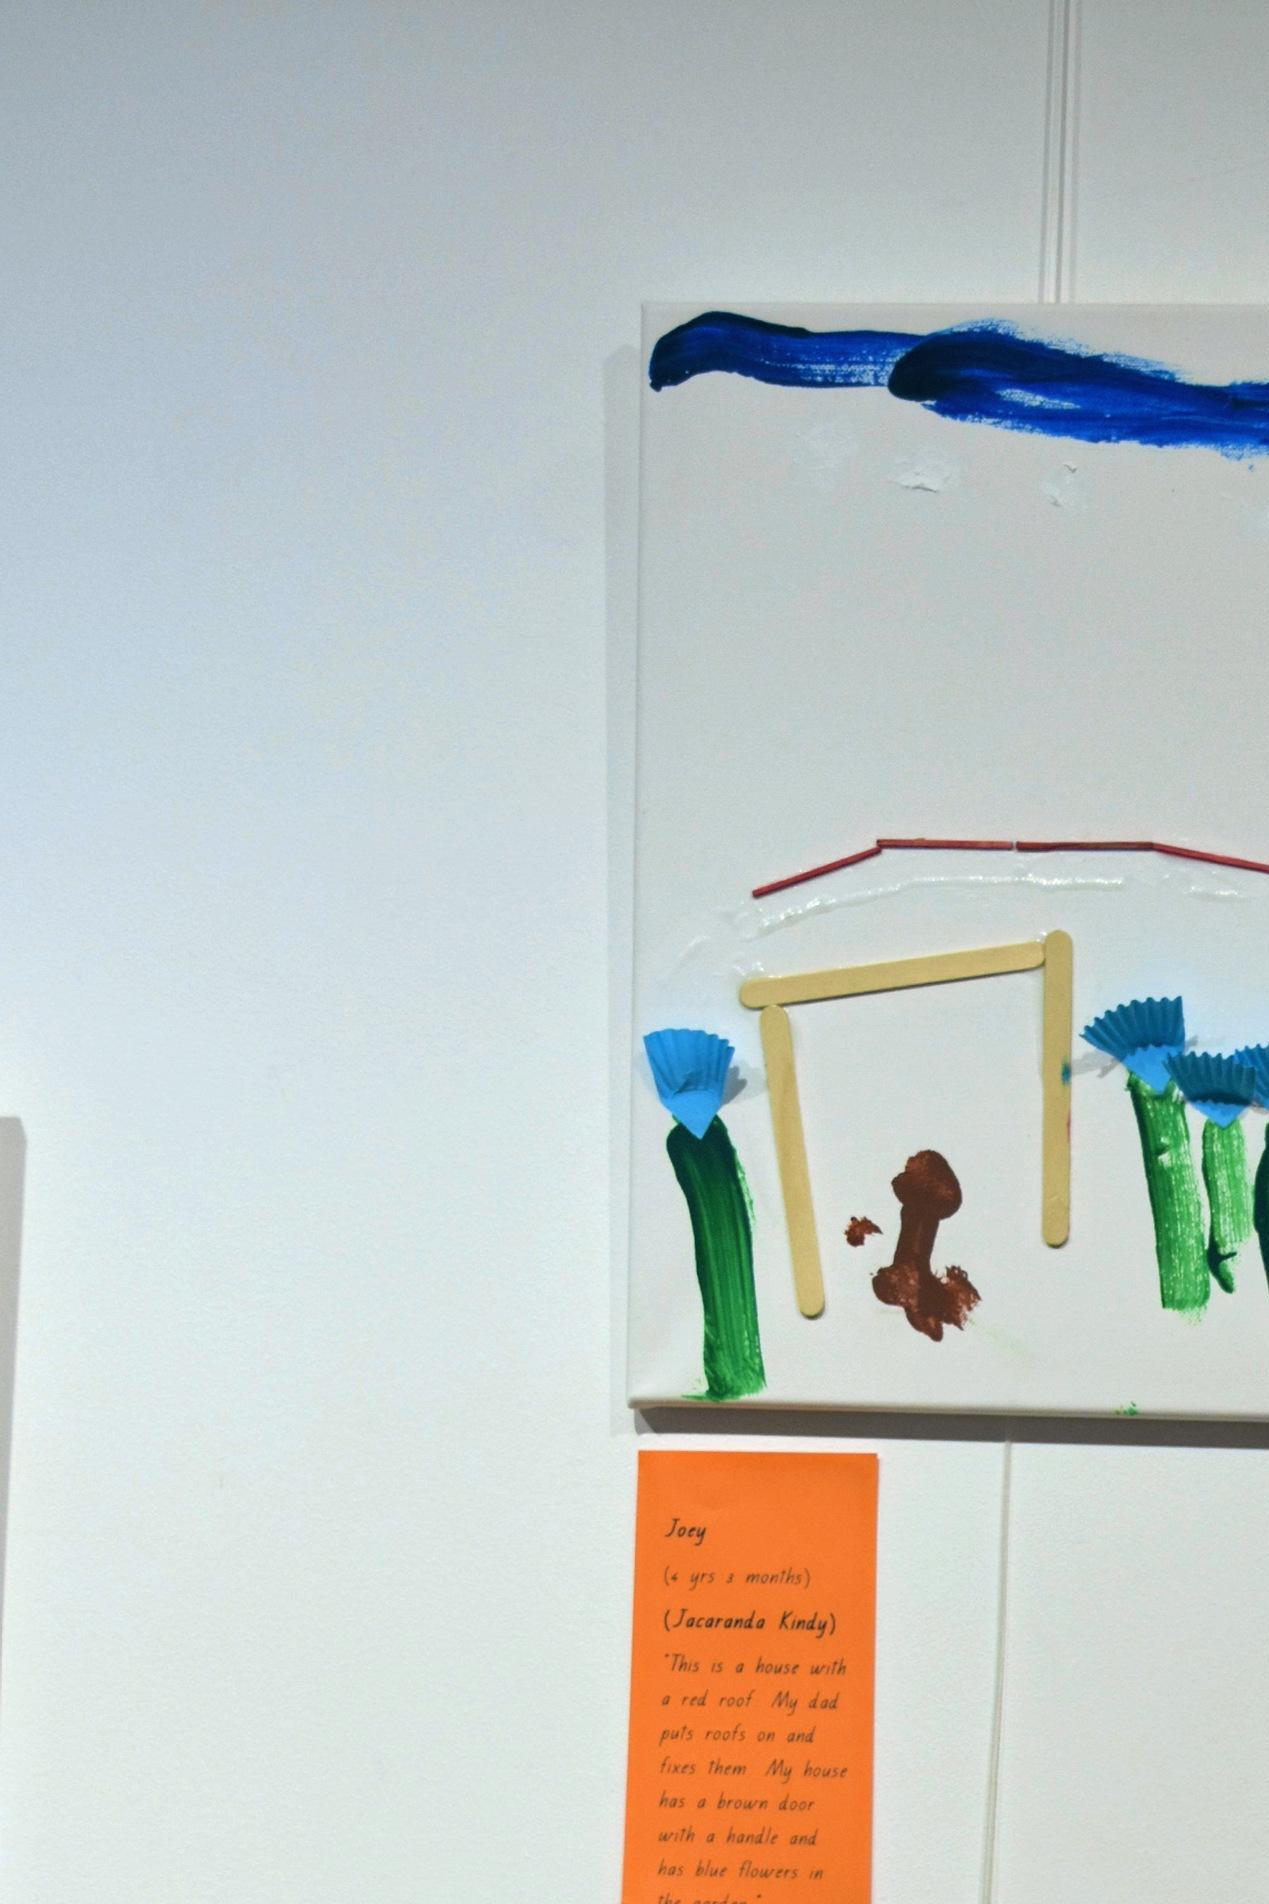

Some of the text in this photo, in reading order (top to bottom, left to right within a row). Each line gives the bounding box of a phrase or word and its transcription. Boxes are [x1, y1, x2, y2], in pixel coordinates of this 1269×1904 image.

[665, 1518, 707, 1546] Joey
[690, 1571, 716, 1591] yrs
[745, 1567, 811, 1589] months)
[664, 1608, 836, 1639] (Jacaranda Kindy)
[711, 1659, 723, 1673] is
[735, 1663, 745, 1673] a
[755, 1656, 800, 1674] house
[810, 1657, 847, 1676] with
[661, 1694, 671, 1706] a
[682, 1689, 709, 1706] red
[770, 1690, 798, 1716] My
[808, 1690, 840, 1710] dad
[659, 1723, 816, 1746] puts roofs on and
[660, 1756, 697, 1775] fixes
[765, 1759, 793, 1784] My
[803, 1760, 848, 1779] house
[659, 1790, 814, 1811] has a brown door
[658, 1825, 819, 1846] with a handle and
[657, 1858, 824, 1880] has blue flowers in
